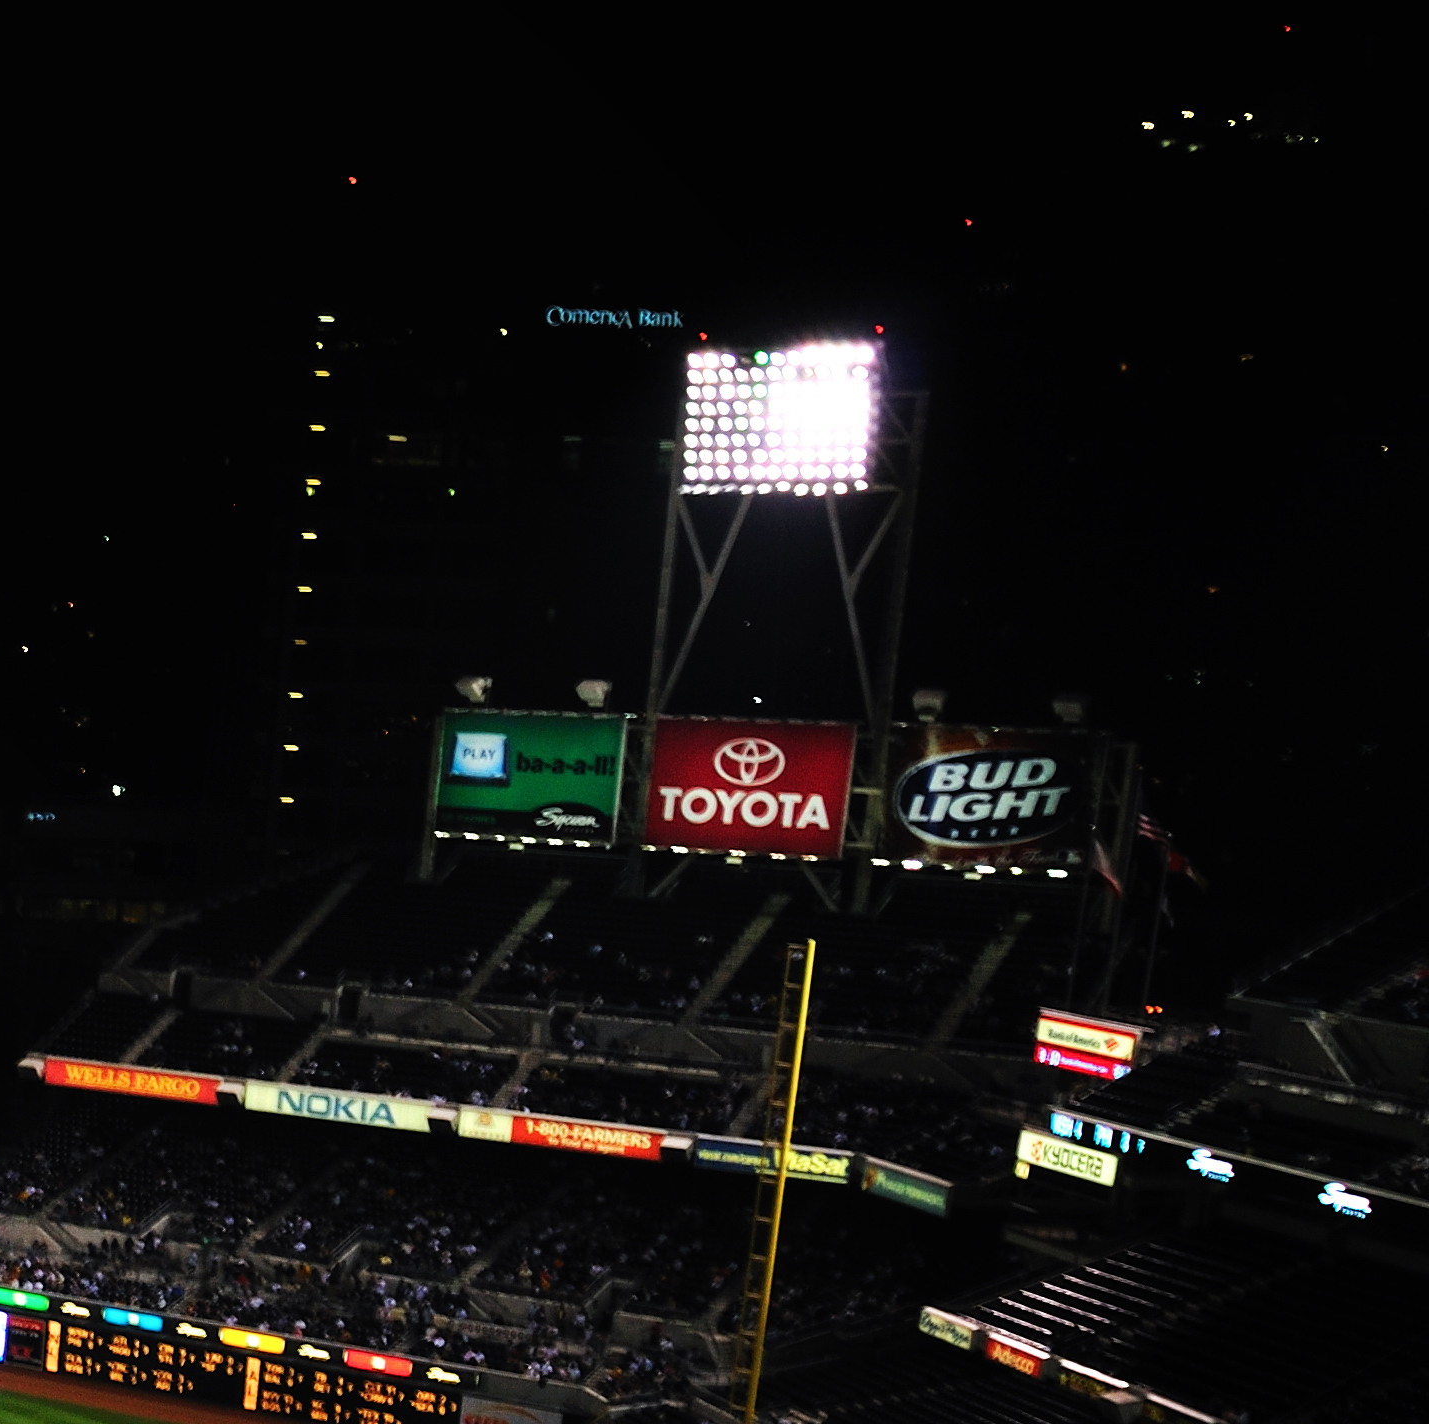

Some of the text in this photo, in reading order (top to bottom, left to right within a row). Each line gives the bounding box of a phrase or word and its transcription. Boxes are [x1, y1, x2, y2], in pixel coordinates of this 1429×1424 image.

[639, 308, 684, 328] Bank
[463, 748, 496, 761] PLAY
[928, 757, 1057, 792] BUD
[658, 786, 830, 830] TOYOTA
[908, 787, 1071, 823] LIGHT
[65, 1064, 201, 1098] WELLS FARGO
[278, 1090, 395, 1124] NOKIA
[526, 1120, 651, 1149] 1-800-FARMERS
[1043, 1143, 1103, 1179] KYOCERA
